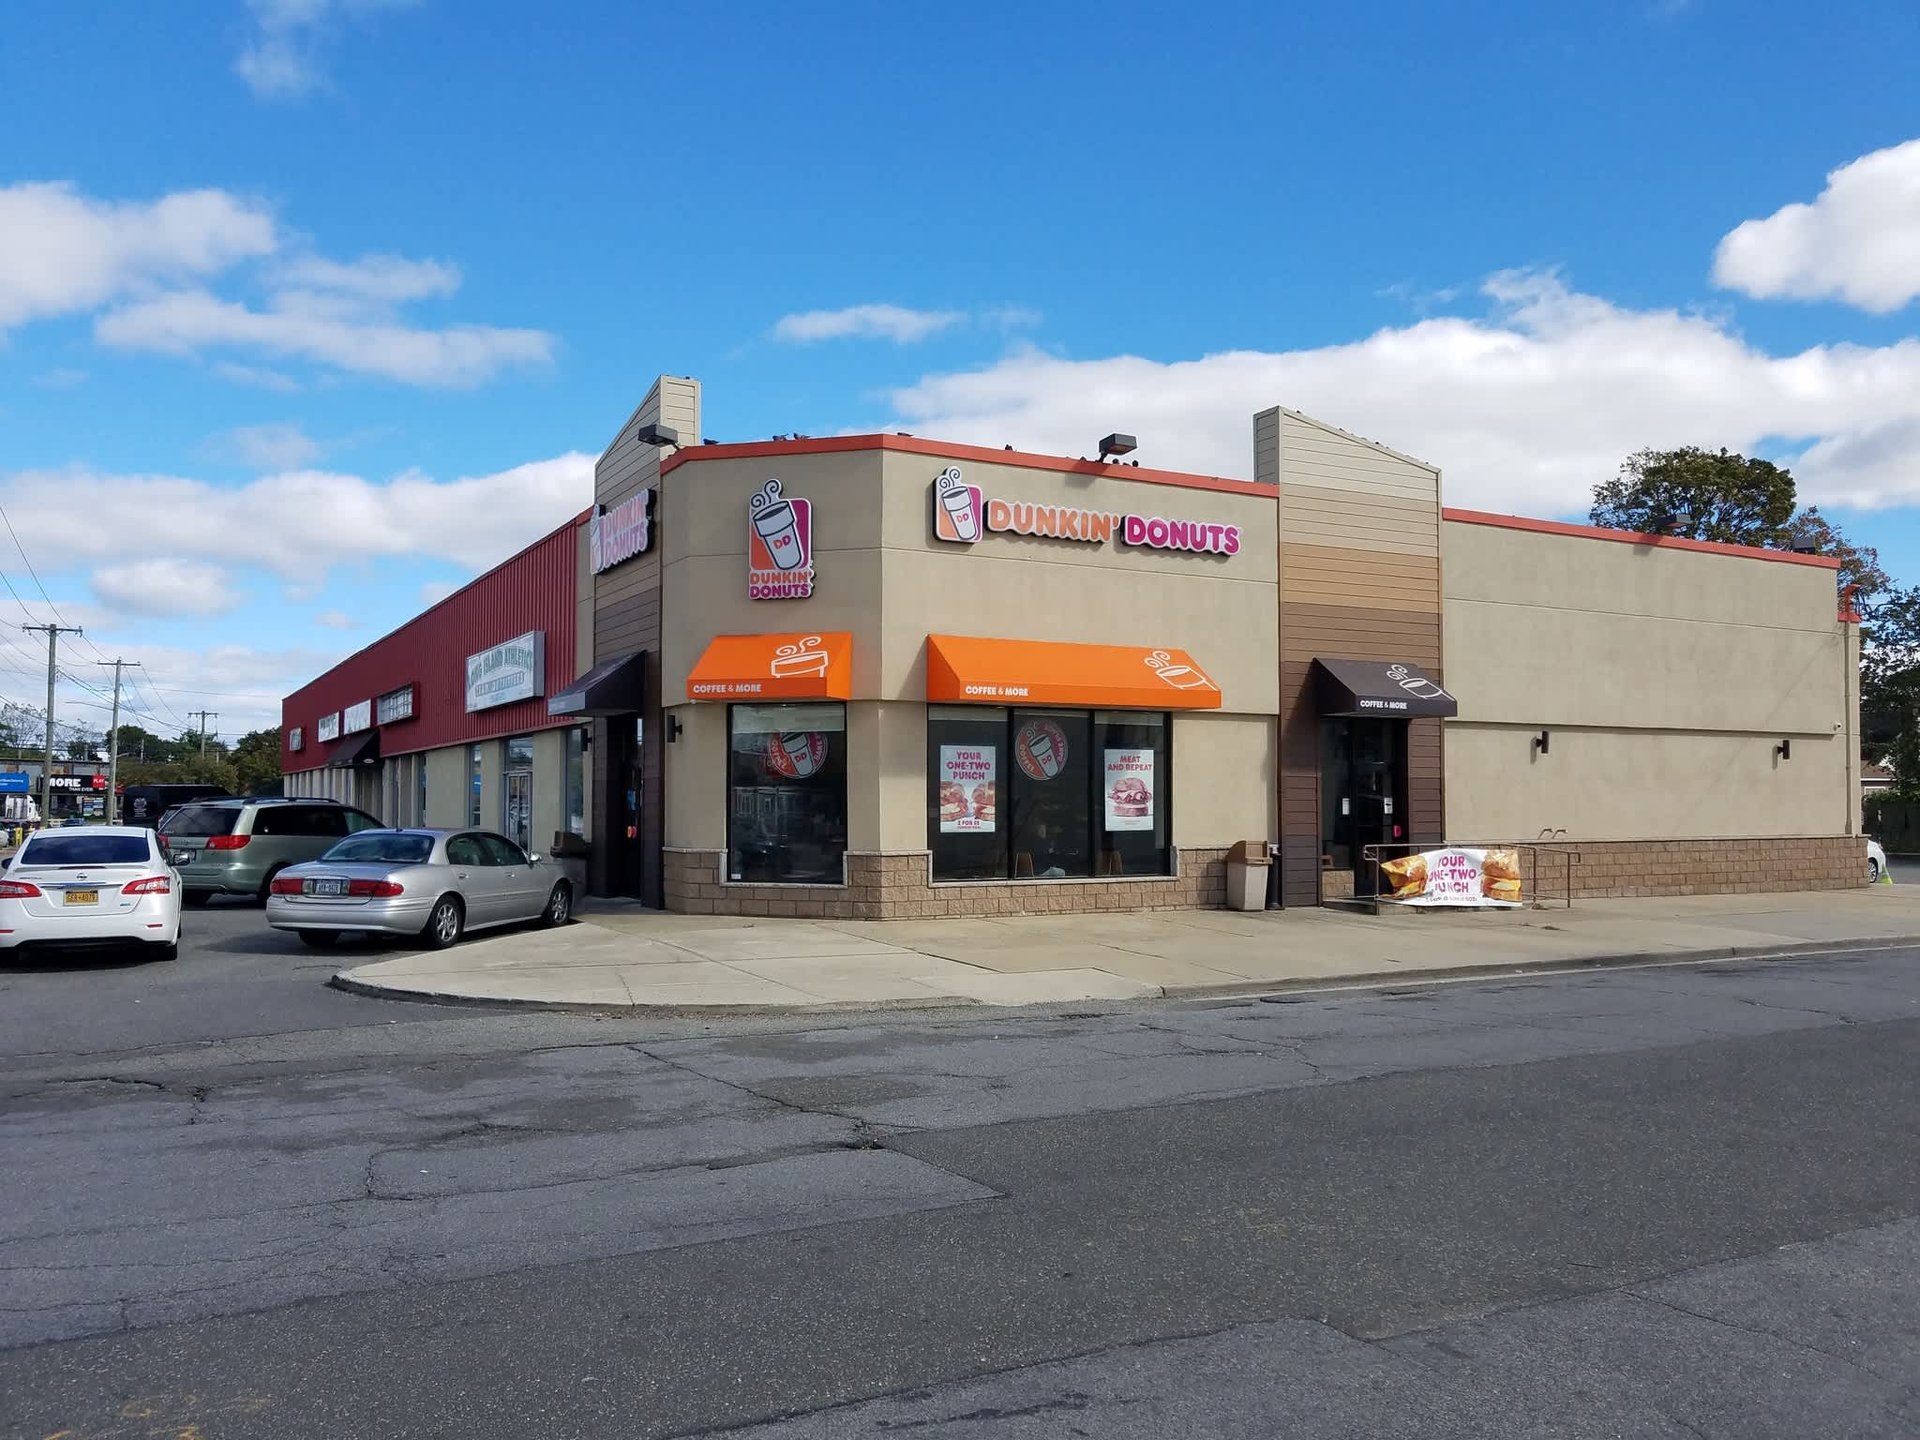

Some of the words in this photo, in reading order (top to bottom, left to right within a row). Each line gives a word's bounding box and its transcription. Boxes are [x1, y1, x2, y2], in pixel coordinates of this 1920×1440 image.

[956, 512, 969, 523] DD
[986, 500, 1120, 542] DUNKIN'
[1127, 515, 1239, 554] DONUTS
[604, 520, 648, 569] DONUTS
[773, 535, 791, 550] DD
[750, 570, 812, 585] DUNKIN'
[750, 583, 809, 598] DONUTS
[693, 684, 727, 693] COFFEE
[728, 684, 734, 692] &
[735, 684, 762, 692] MORE
[965, 685, 997, 695] COFFEE
[998, 687, 1004, 695] &
[1005, 687, 1029, 696] MORE
[1360, 700, 1384, 708] COFFEE
[1389, 701, 1408, 709] MORE
[957, 752, 981, 760] YOUR
[1120, 755, 1141, 763] MEAT
[947, 762, 991, 770] ONE-TWO
[1108, 763, 1125, 771] AND
[1126, 763, 1152, 771] REPEAT
[953, 772, 985, 780] PUNCH
